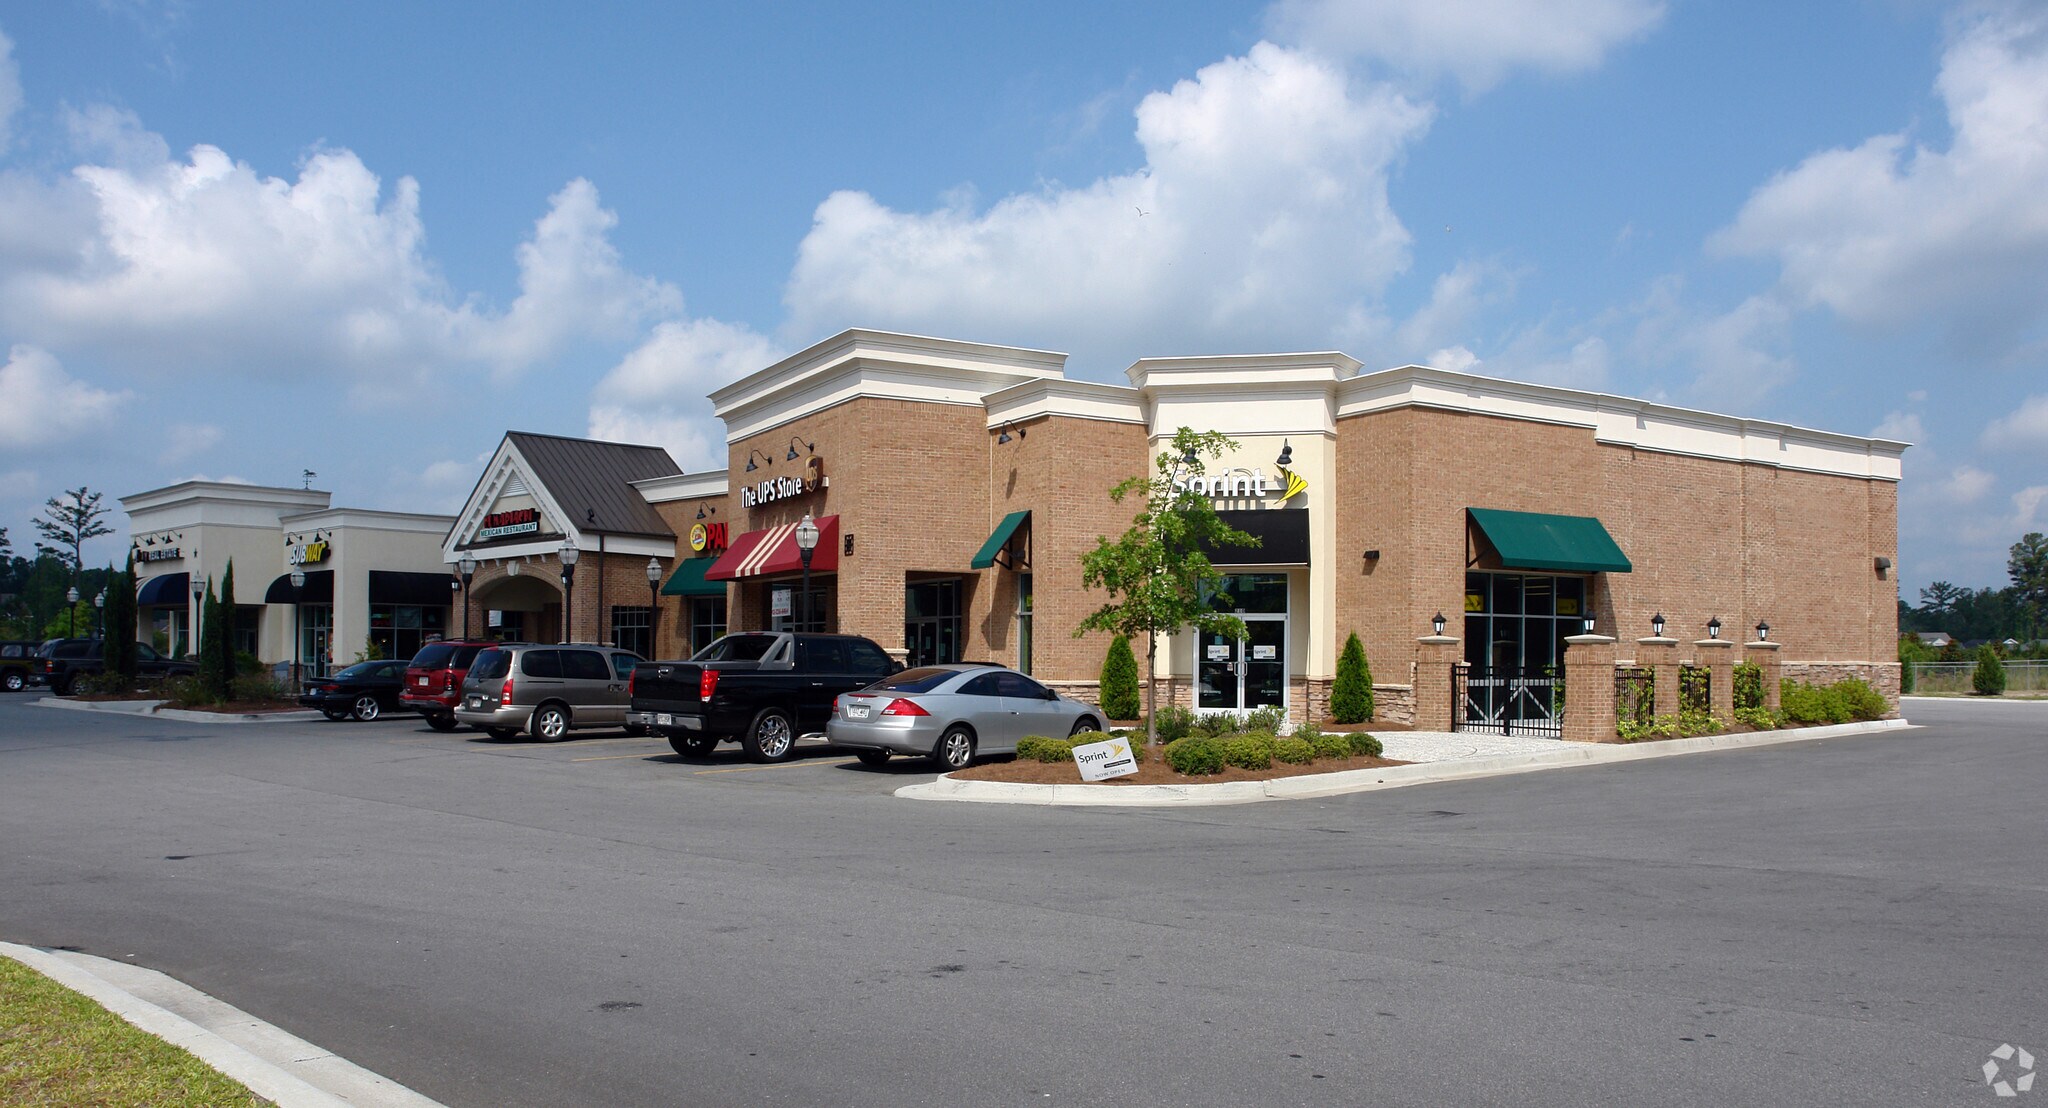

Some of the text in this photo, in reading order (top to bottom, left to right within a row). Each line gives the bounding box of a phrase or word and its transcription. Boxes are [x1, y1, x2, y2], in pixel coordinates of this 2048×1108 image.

[741, 476, 802, 508] The UPS Store
[1171, 468, 1266, 498] Sprint
[480, 523, 536, 537] MEXICAN RESTAURANT
[290, 541, 326, 564] SUBWAY
[1078, 750, 1108, 764] Sprint
